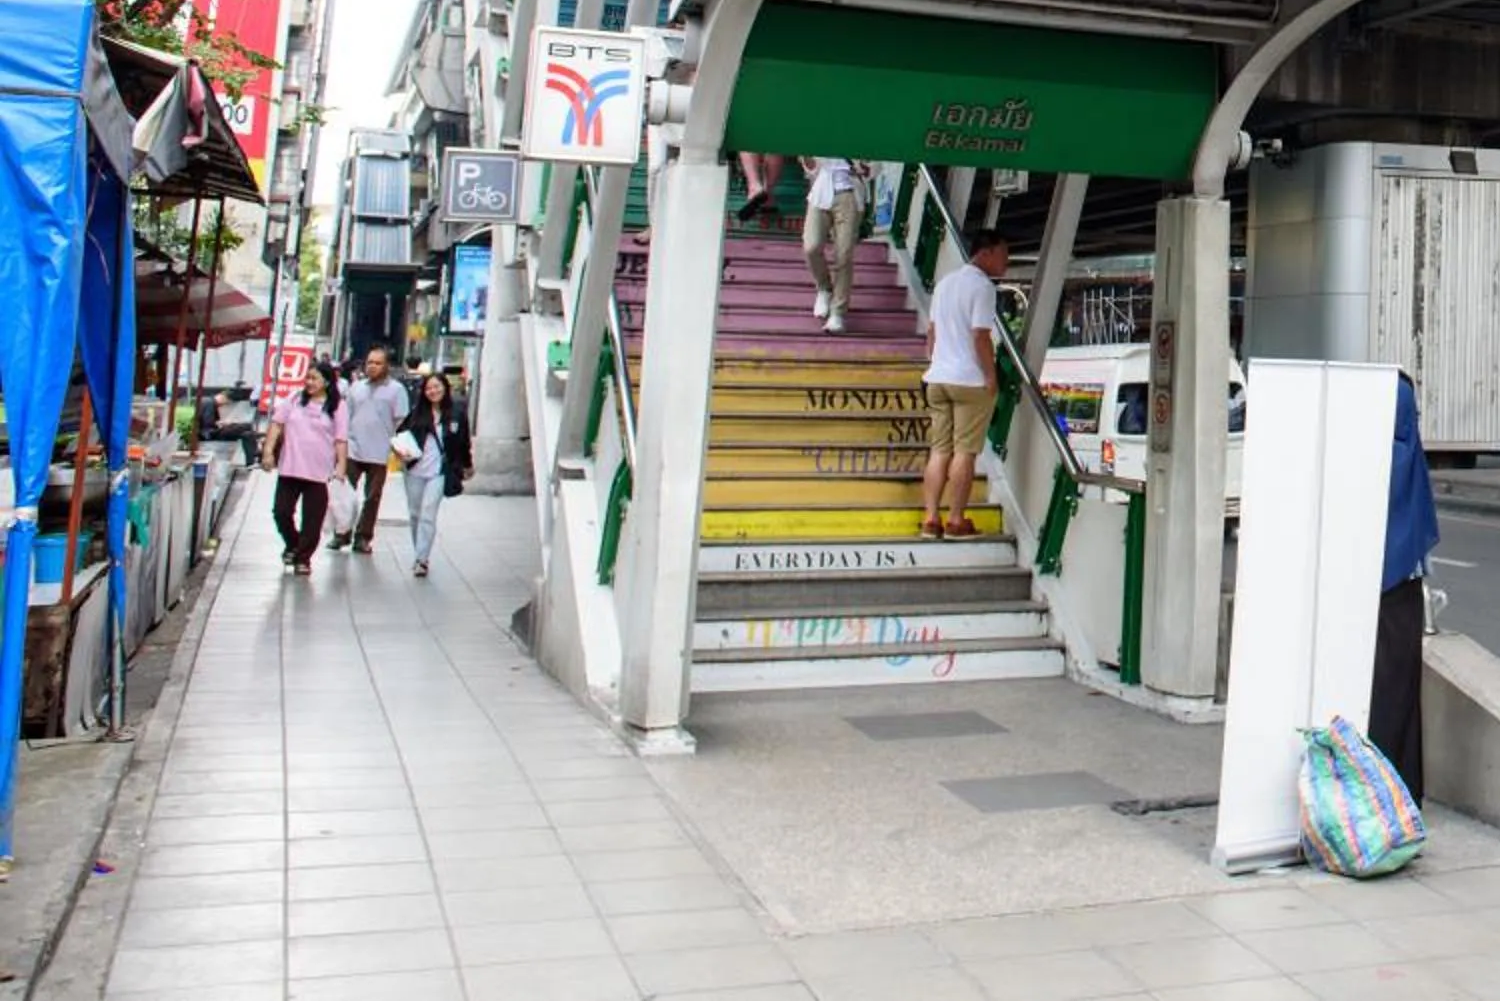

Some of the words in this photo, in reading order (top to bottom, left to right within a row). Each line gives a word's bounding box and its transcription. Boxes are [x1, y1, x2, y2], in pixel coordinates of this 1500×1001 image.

[547, 41, 633, 63] BTS
[932, 99, 1033, 131] เอกมัย
[925, 129, 1027, 152] Ekkamai
[458, 162, 482, 187] P
[735, 551, 867, 570] EVERYDAY
[874, 550, 896, 567] IS
[904, 550, 918, 567] A
[874, 615, 957, 677] Day
